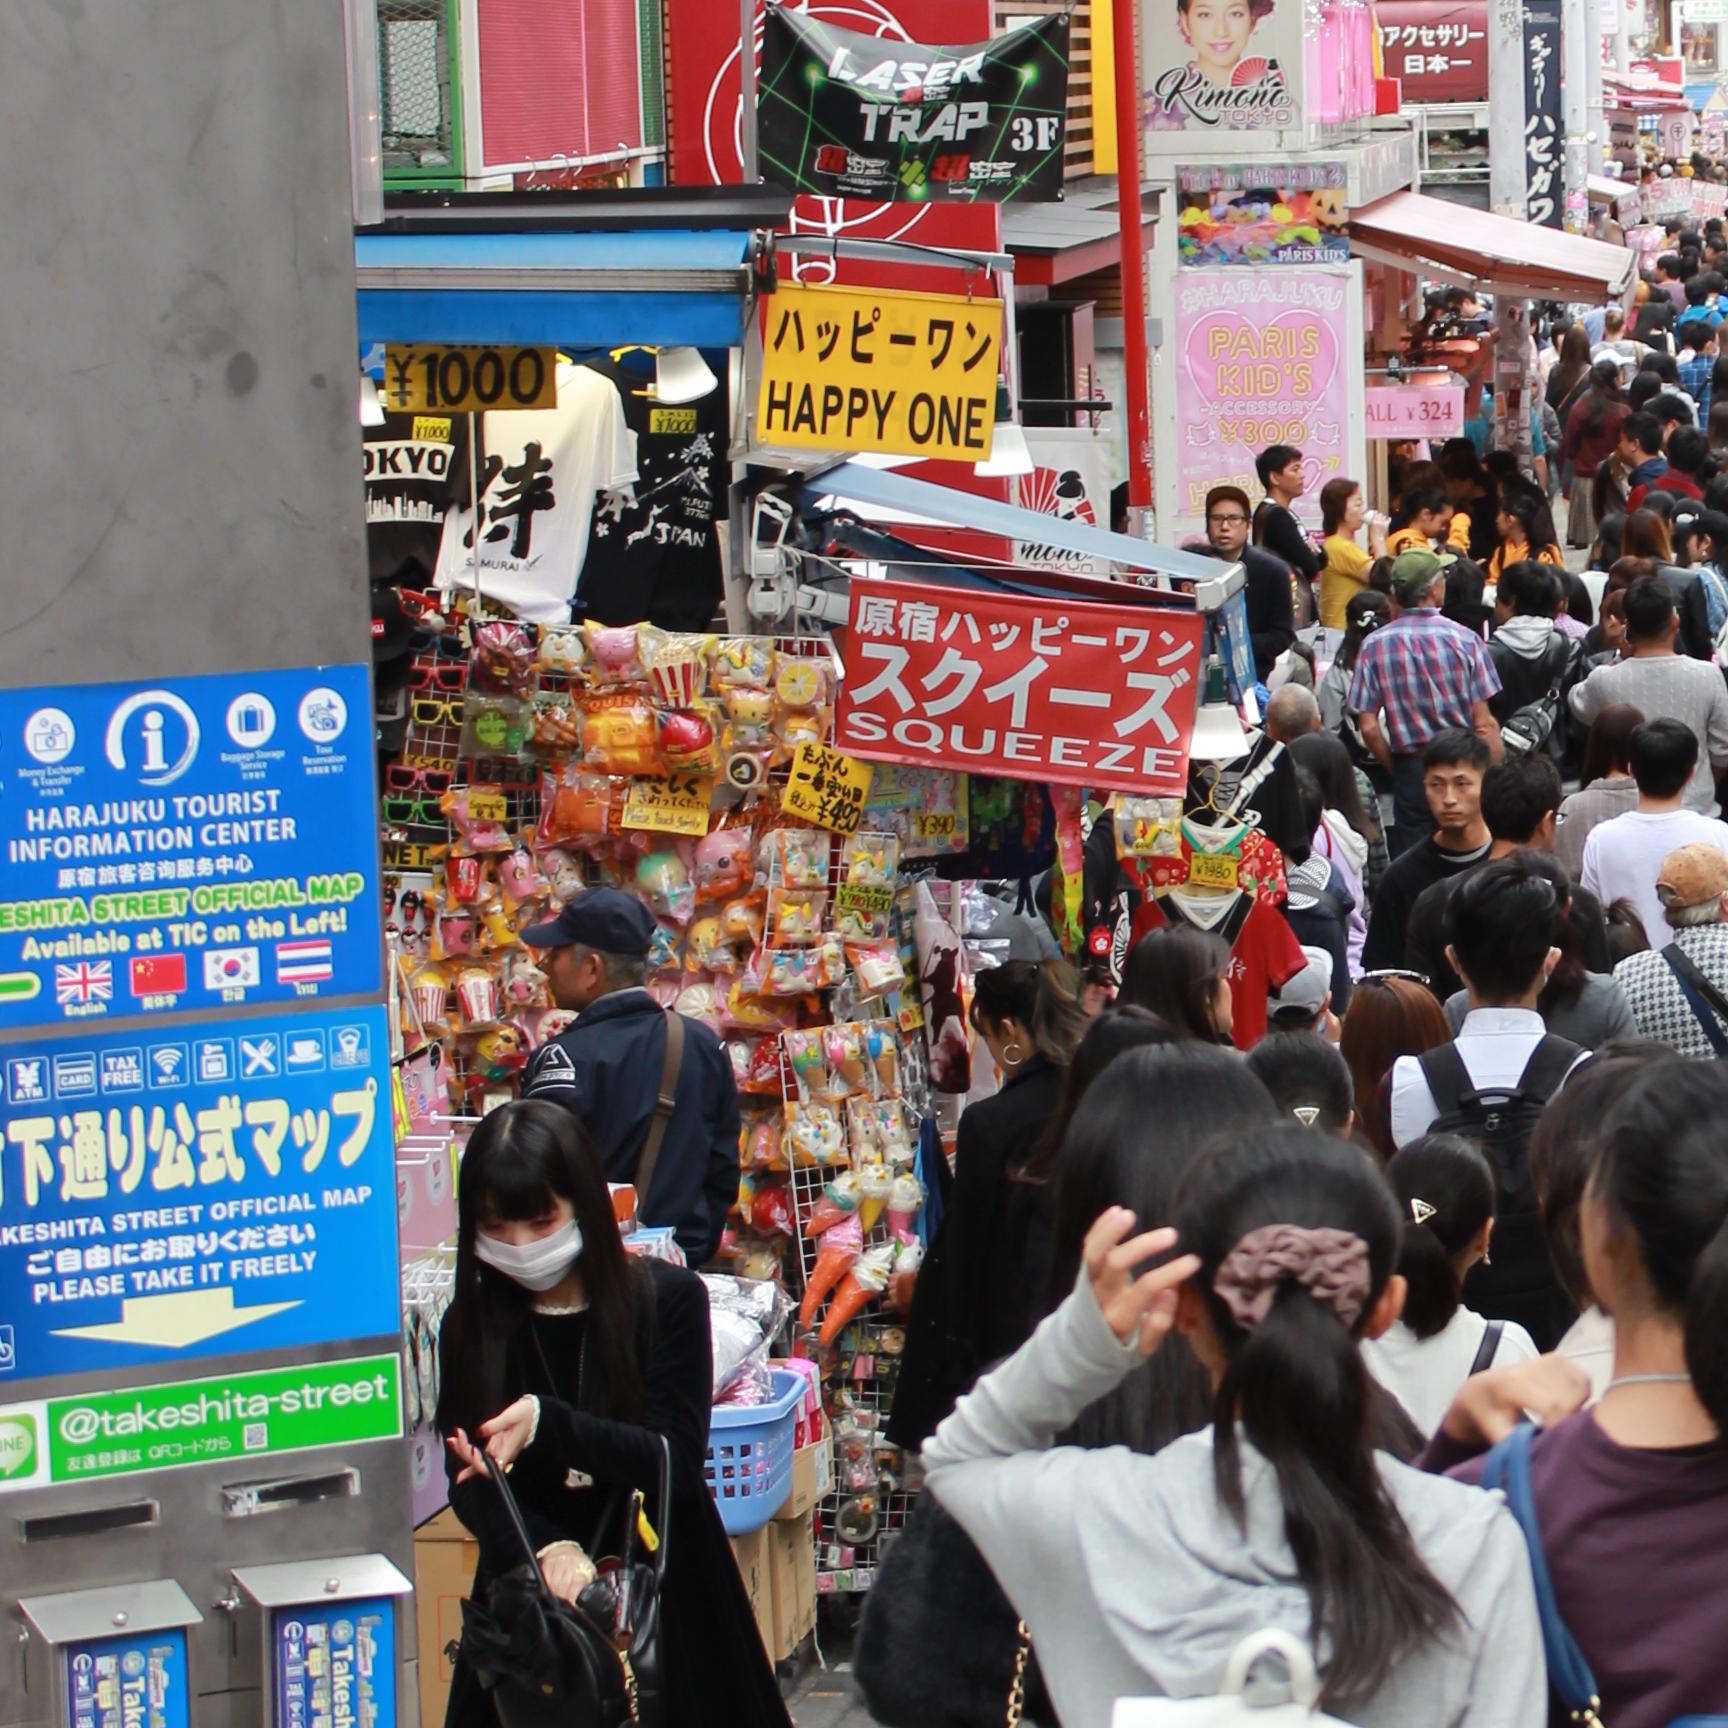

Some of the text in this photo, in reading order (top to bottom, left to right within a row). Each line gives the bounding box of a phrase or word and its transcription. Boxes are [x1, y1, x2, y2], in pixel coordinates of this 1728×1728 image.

[829, 45, 987, 91] LASER
[1404, 53, 1473, 74] 日本一
[1155, 68, 1291, 125] Kimono
[1220, 109, 1290, 123] TOKYO
[860, 101, 989, 143] TRAP
[1011, 116, 1060, 152] 3F
[1524, 114, 1559, 224] ハセガワ
[773, 305, 993, 373] ハッピーワン
[1207, 325, 1322, 361] PARIS
[1217, 362, 1314, 398] KID'S
[765, 380, 988, 449] HAPPY ONE
[465, 558, 520, 572] SMURAI
[855, 594, 1195, 668] 原宿ハッピーワン
[849, 641, 1191, 745] スクイーズ
[845, 711, 1187, 779] SQUEEZE
[26, 789, 281, 832] HARAJUKU TOURIST
[918, 814, 955, 835] ¥390
[9, 817, 297, 863] INFORMATION CENTER
[58, 852, 253, 889] 原宿旅客咨询服务中心
[92, 889, 190, 923] STREET
[194, 881, 306, 914] OFFICIAL
[308, 873, 365, 905] MAP
[22, 907, 348, 961] Available at TIC on the Left!
[60, 1071, 93, 1088] CARD
[105, 1068, 142, 1086] FREE
[106, 1055, 137, 1072] TAX
[14, 1085, 43, 1102] ATM
[0, 1076, 378, 1208] 下通り公式マップ
[112, 1185, 373, 1232] STREET OFFICIAL MAP
[26, 1221, 317, 1277] ご自由にお取りください
[33, 1250, 318, 1304] PLEASE TAKE IT FREELY
[59, 1373, 389, 1445] @takeshita-street
